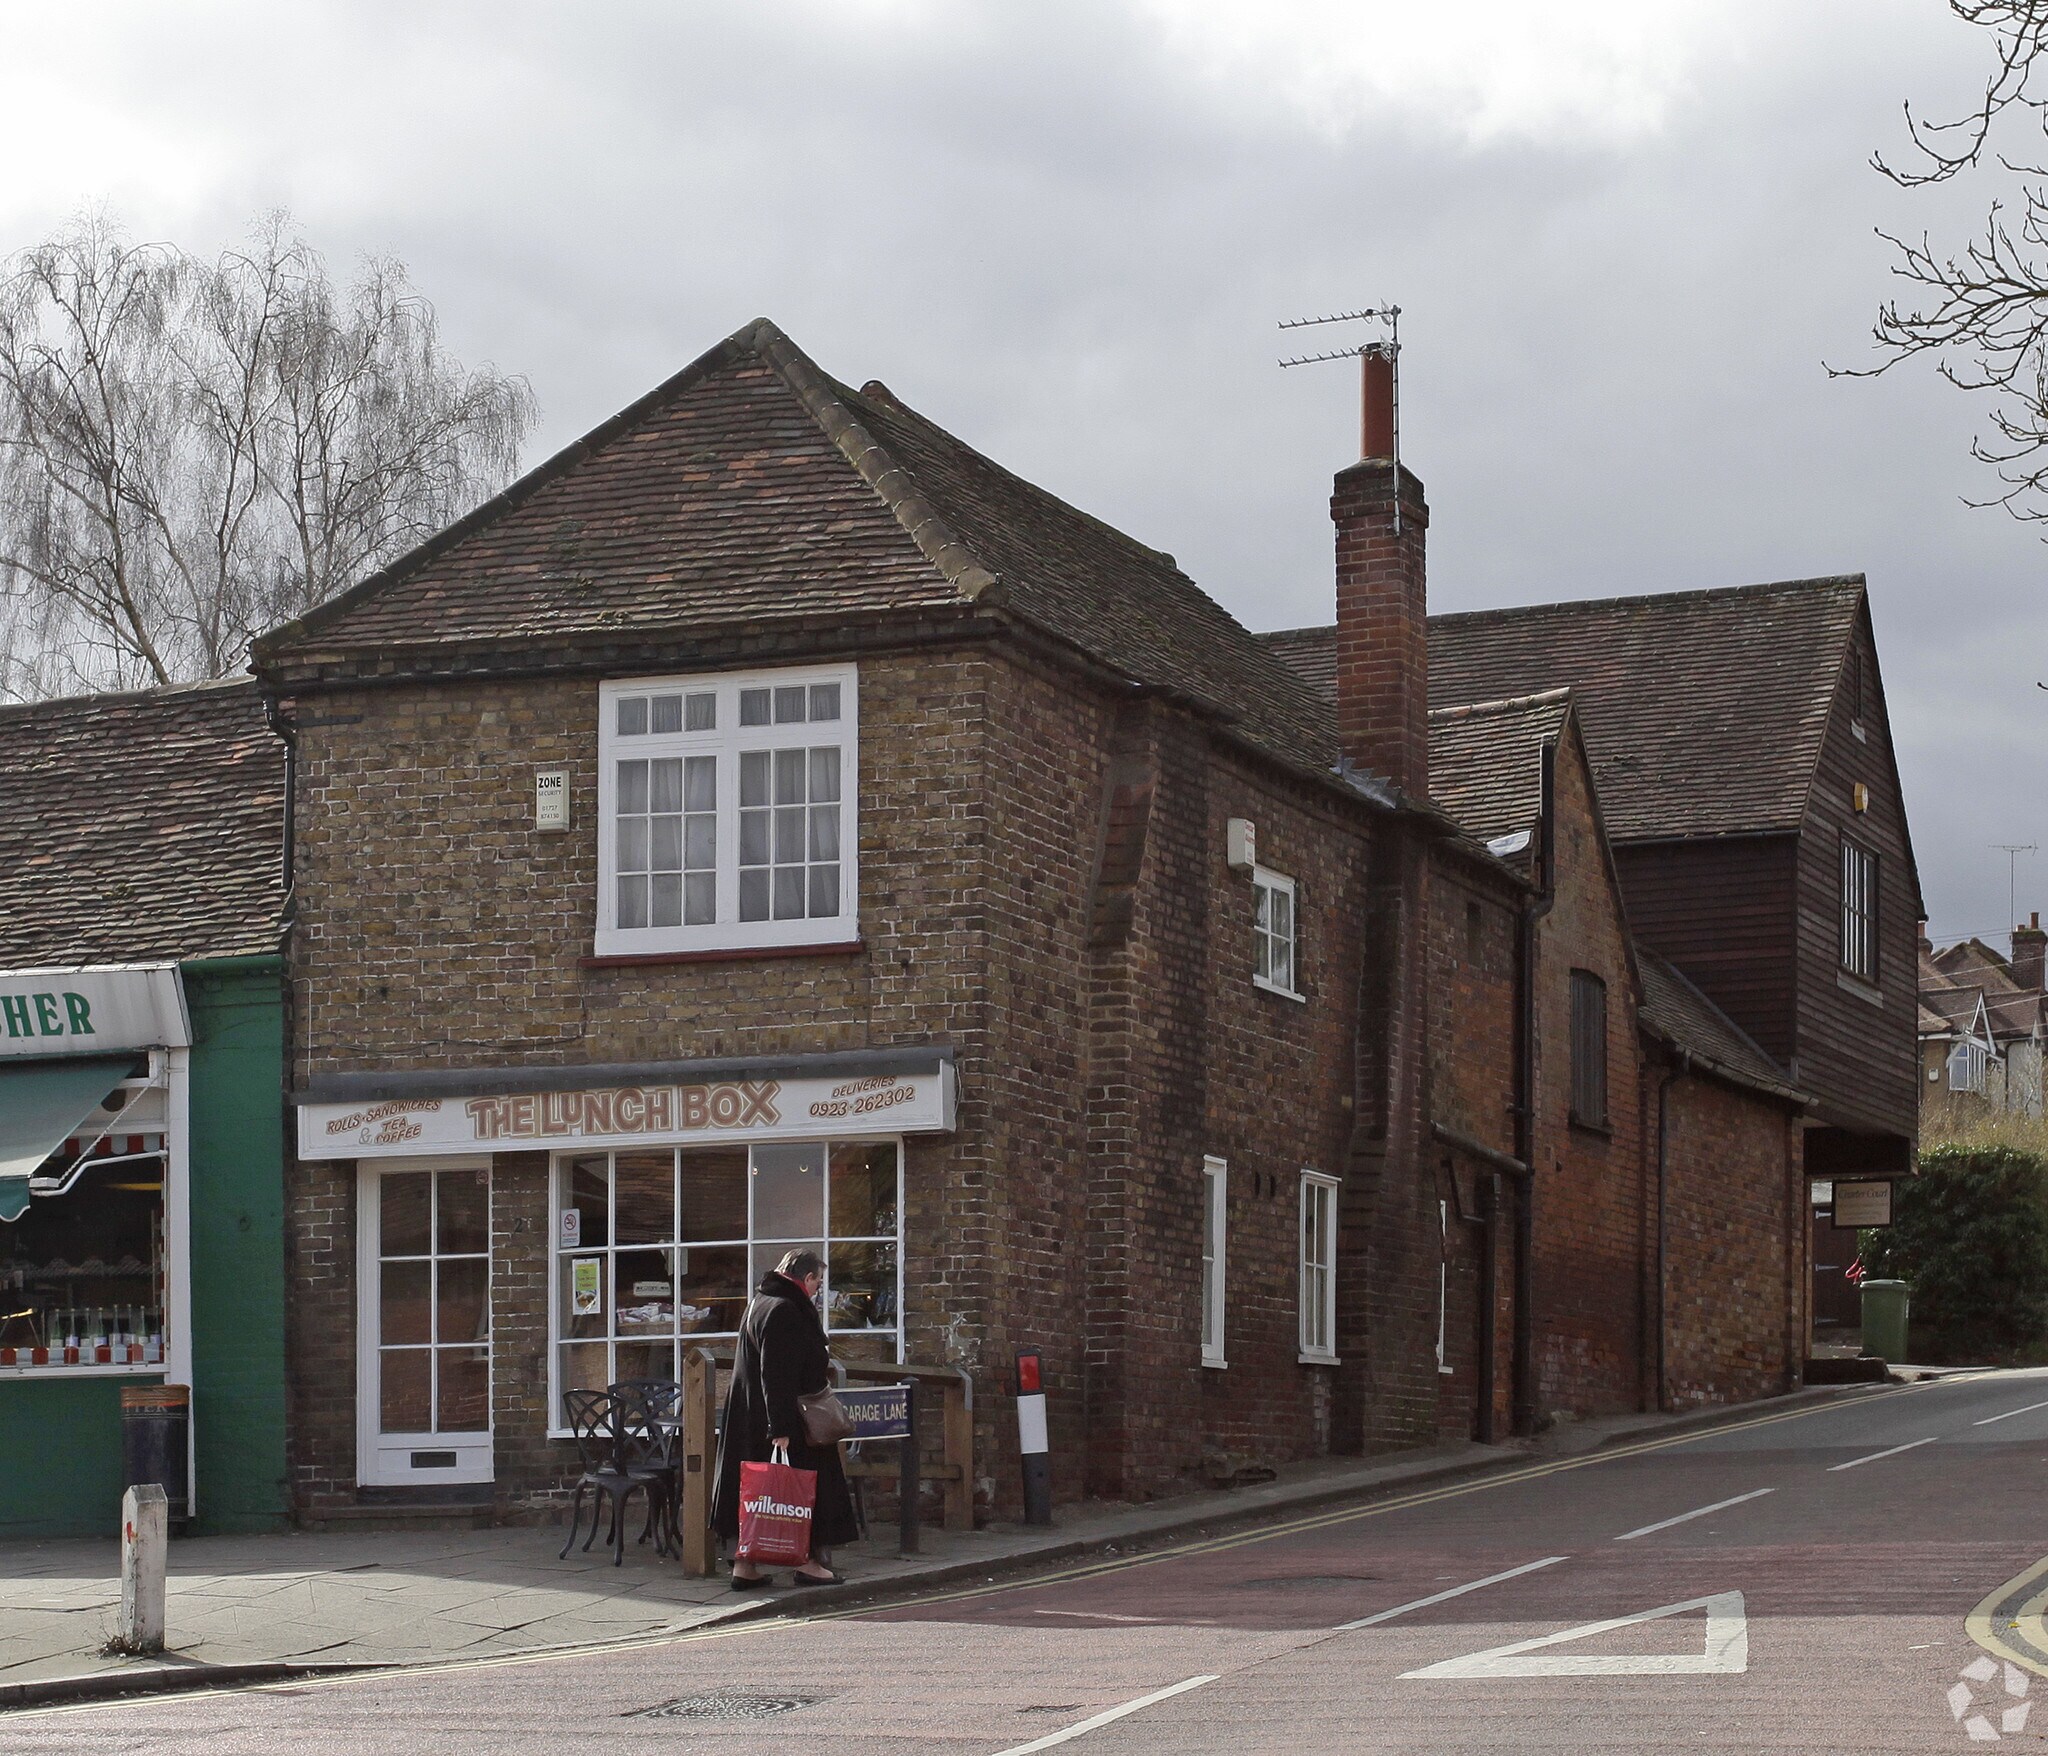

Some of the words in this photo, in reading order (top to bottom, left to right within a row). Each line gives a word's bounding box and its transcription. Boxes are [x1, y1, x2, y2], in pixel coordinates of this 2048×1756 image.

[538, 777, 562, 788] ZONE
[0, 992, 96, 1038] HER
[832, 1075, 897, 1098] DELIVERIES
[465, 1095, 538, 1140] THE
[539, 1085, 674, 1137] LUNCH
[678, 1079, 783, 1130] BOX
[359, 1127, 373, 1145] &
[374, 1124, 422, 1144] COFFEE
[382, 1116, 408, 1132] TEA
[843, 1404, 880, 1422] ARAGE
[884, 1402, 908, 1420] LANE
[743, 1495, 812, 1519] wilkinson
